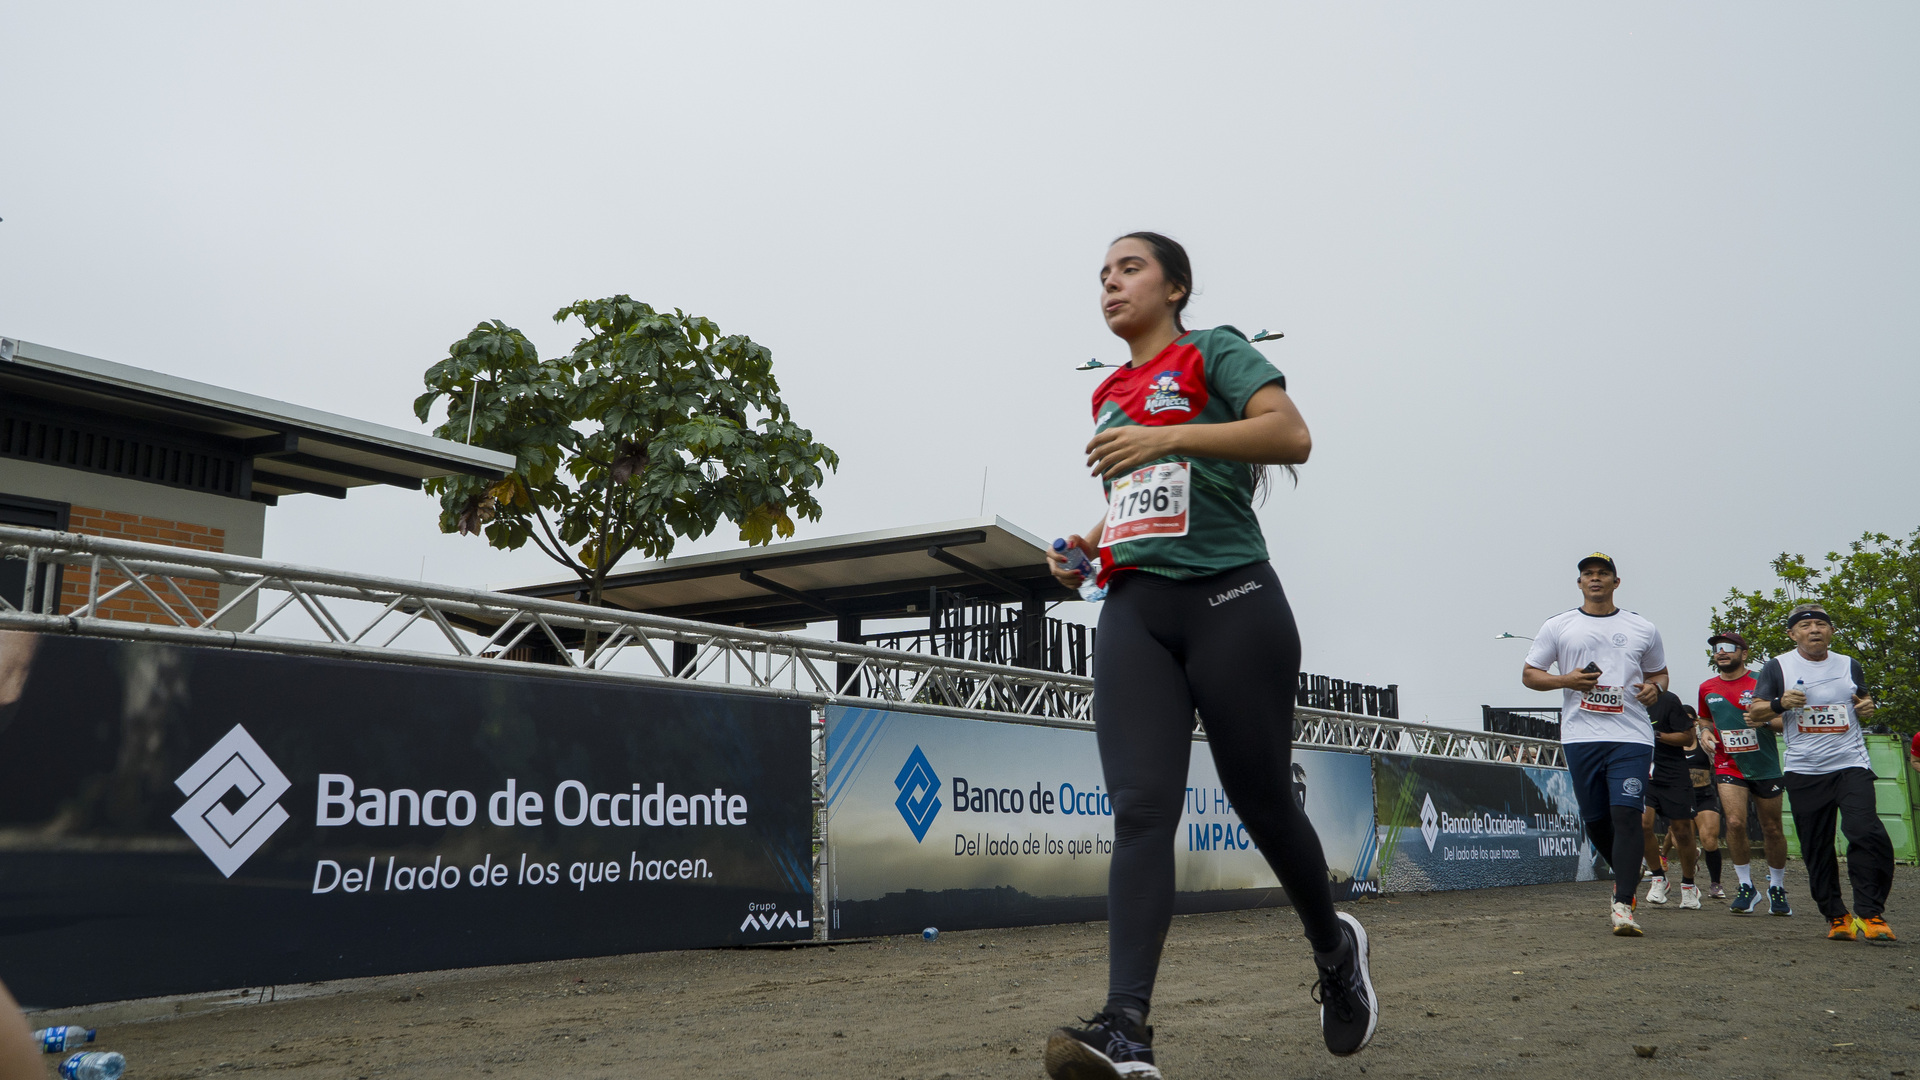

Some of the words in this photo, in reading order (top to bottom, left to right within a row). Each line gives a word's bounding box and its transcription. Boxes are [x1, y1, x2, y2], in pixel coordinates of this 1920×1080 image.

[1118, 486, 1169, 520] 1796
[1208, 580, 1263, 607] LIMINAL
[1587, 692, 1618, 705] 2008
[1808, 714, 1836, 725] 125
[1729, 736, 1749, 746] 510
[316, 773, 477, 827] Banco
[488, 778, 544, 827] de
[554, 780, 748, 827] Occidente
[952, 776, 1024, 814] Banco
[1029, 781, 1055, 815] de
[1059, 782, 1112, 816] Occid
[1185, 787, 1207, 815] TU
[1441, 811, 1471, 834] Banco
[1471, 812, 1484, 834] de
[1483, 812, 1527, 835] Occidente
[1534, 813, 1547, 832] TU
[954, 833, 981, 856] Del
[985, 832, 1019, 856] lado
[1022, 832, 1041, 855] de
[1044, 832, 1064, 855] los
[1067, 839, 1093, 860] que
[1188, 823, 1259, 851] IMPAC
[1538, 837, 1580, 857] IMPACTA.
[1443, 846, 1455, 861] Del
[1455, 845, 1470, 860] lado
[1470, 845, 1479, 860] de
[1479, 845, 1489, 860] los
[1489, 849, 1501, 862] que
[312, 856, 376, 894] Del
[384, 854, 461, 891] lado
[469, 853, 509, 887] de
[518, 852, 560, 885] los
[569, 861, 621, 892] que
[628, 850, 714, 881] hacen.
[1352, 881, 1377, 893] AVAL
[748, 902, 777, 912] Grupo
[740, 910, 810, 933] AVAL
